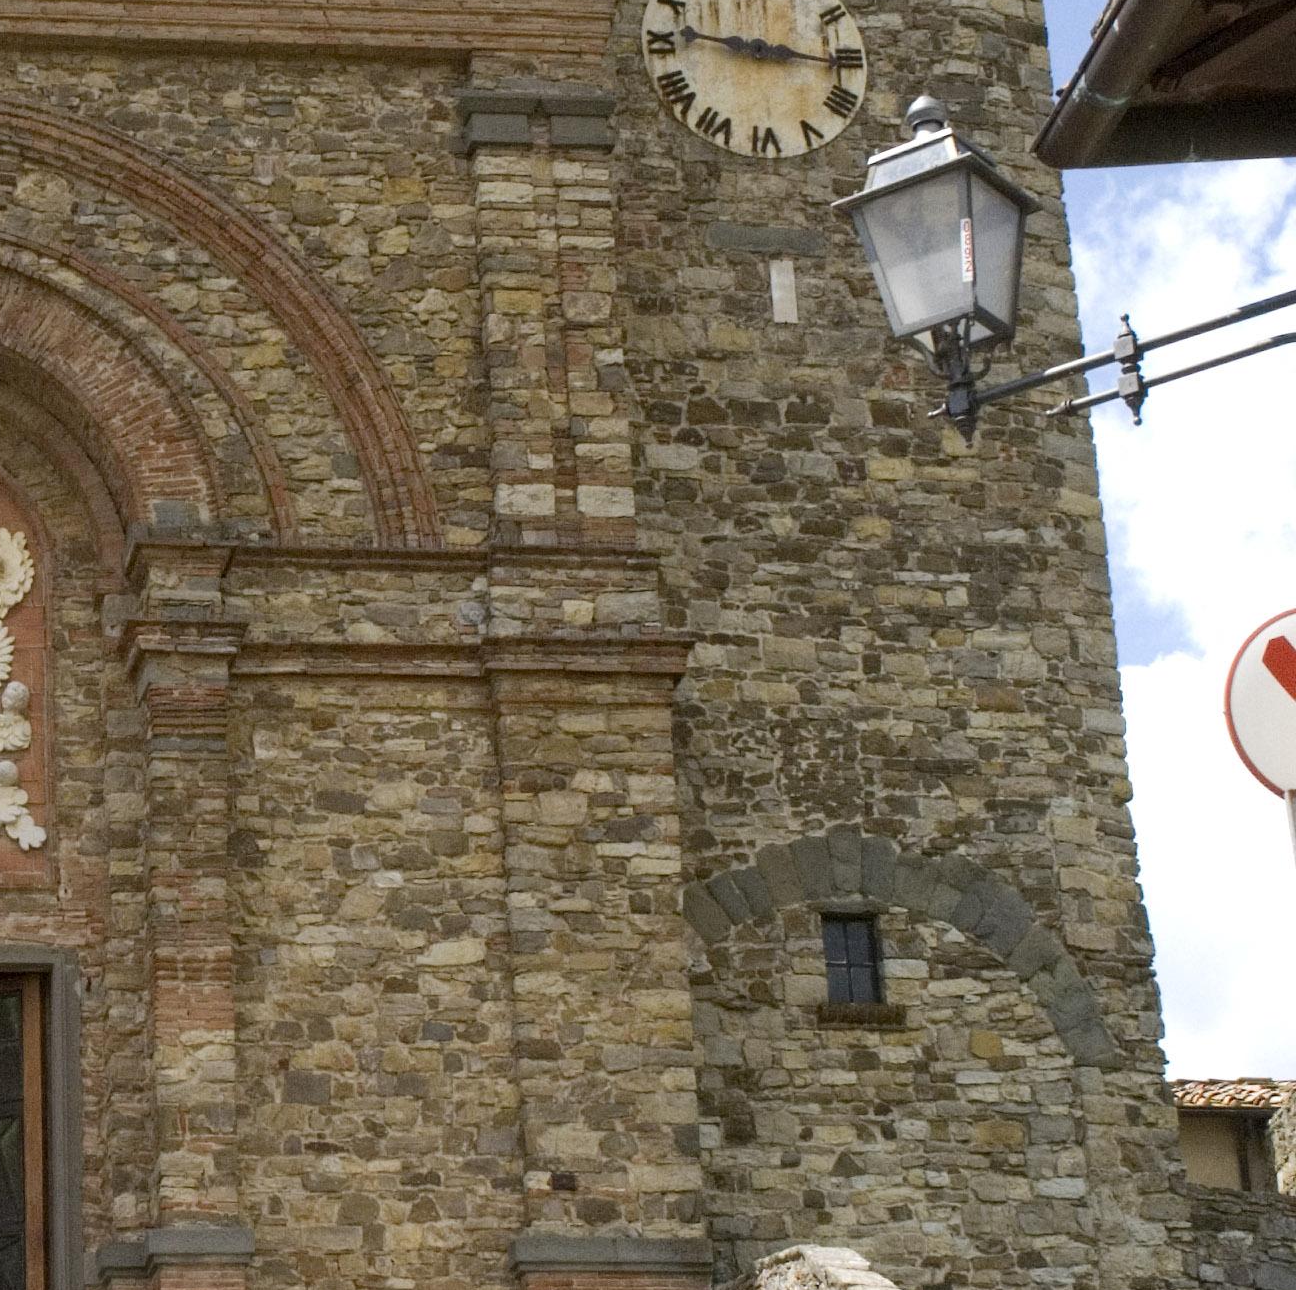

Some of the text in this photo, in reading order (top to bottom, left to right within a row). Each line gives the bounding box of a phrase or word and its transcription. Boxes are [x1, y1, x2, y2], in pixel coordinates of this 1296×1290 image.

[819, 4, 845, 25] II
[835, 49, 862, 68] III
[800, 120, 824, 146] V
